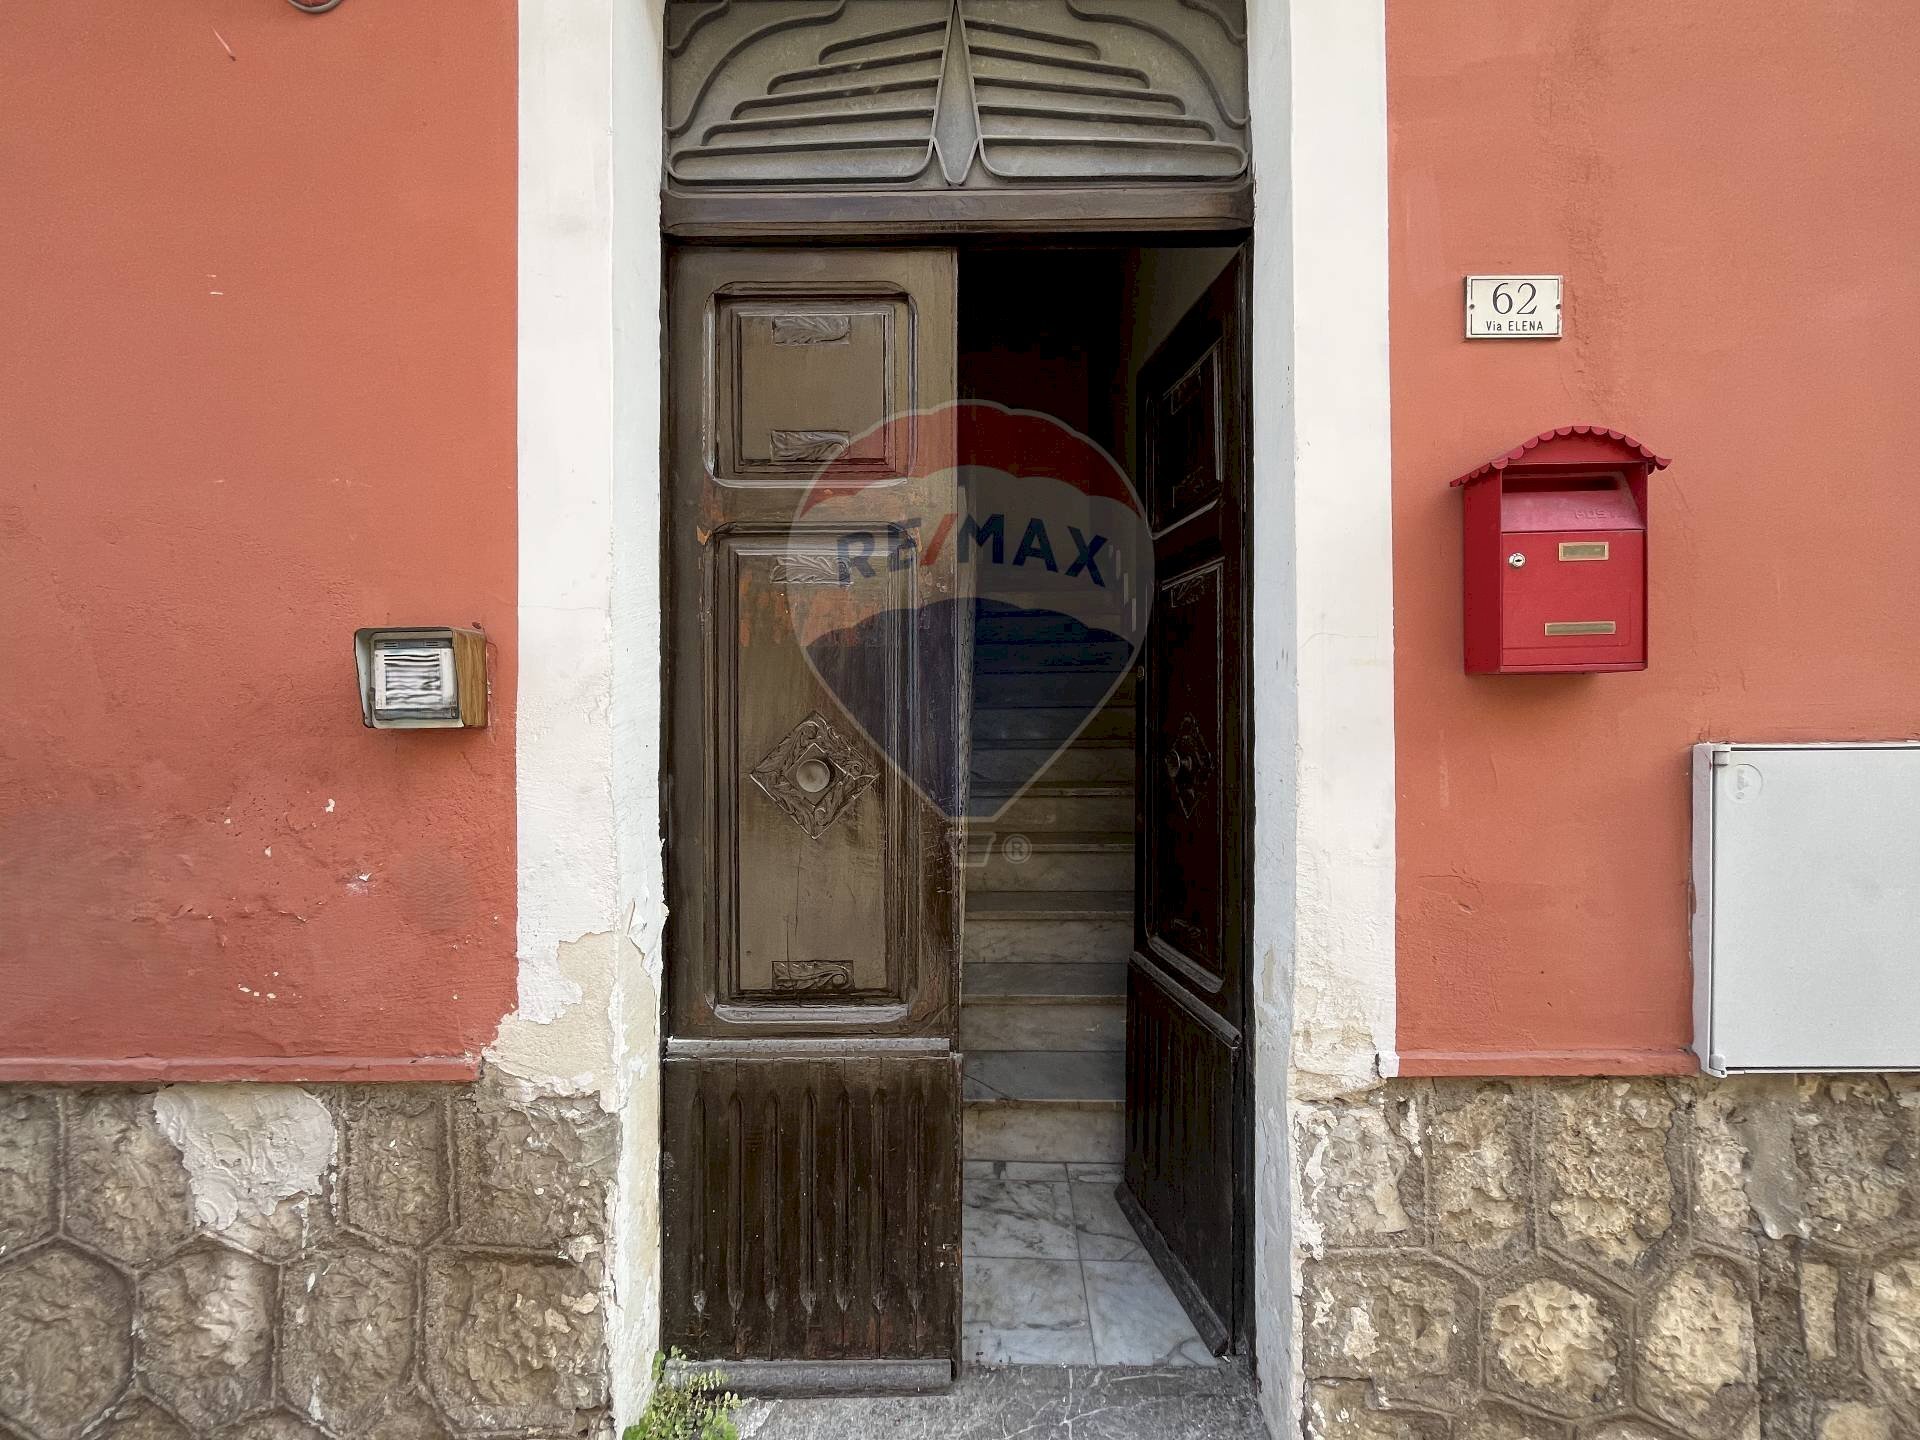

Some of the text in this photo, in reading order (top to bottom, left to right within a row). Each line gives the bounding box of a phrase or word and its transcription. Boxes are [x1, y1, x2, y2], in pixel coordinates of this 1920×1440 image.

[1492, 282, 1538, 315] 62
[1486, 320, 1544, 332] Via ELENA
